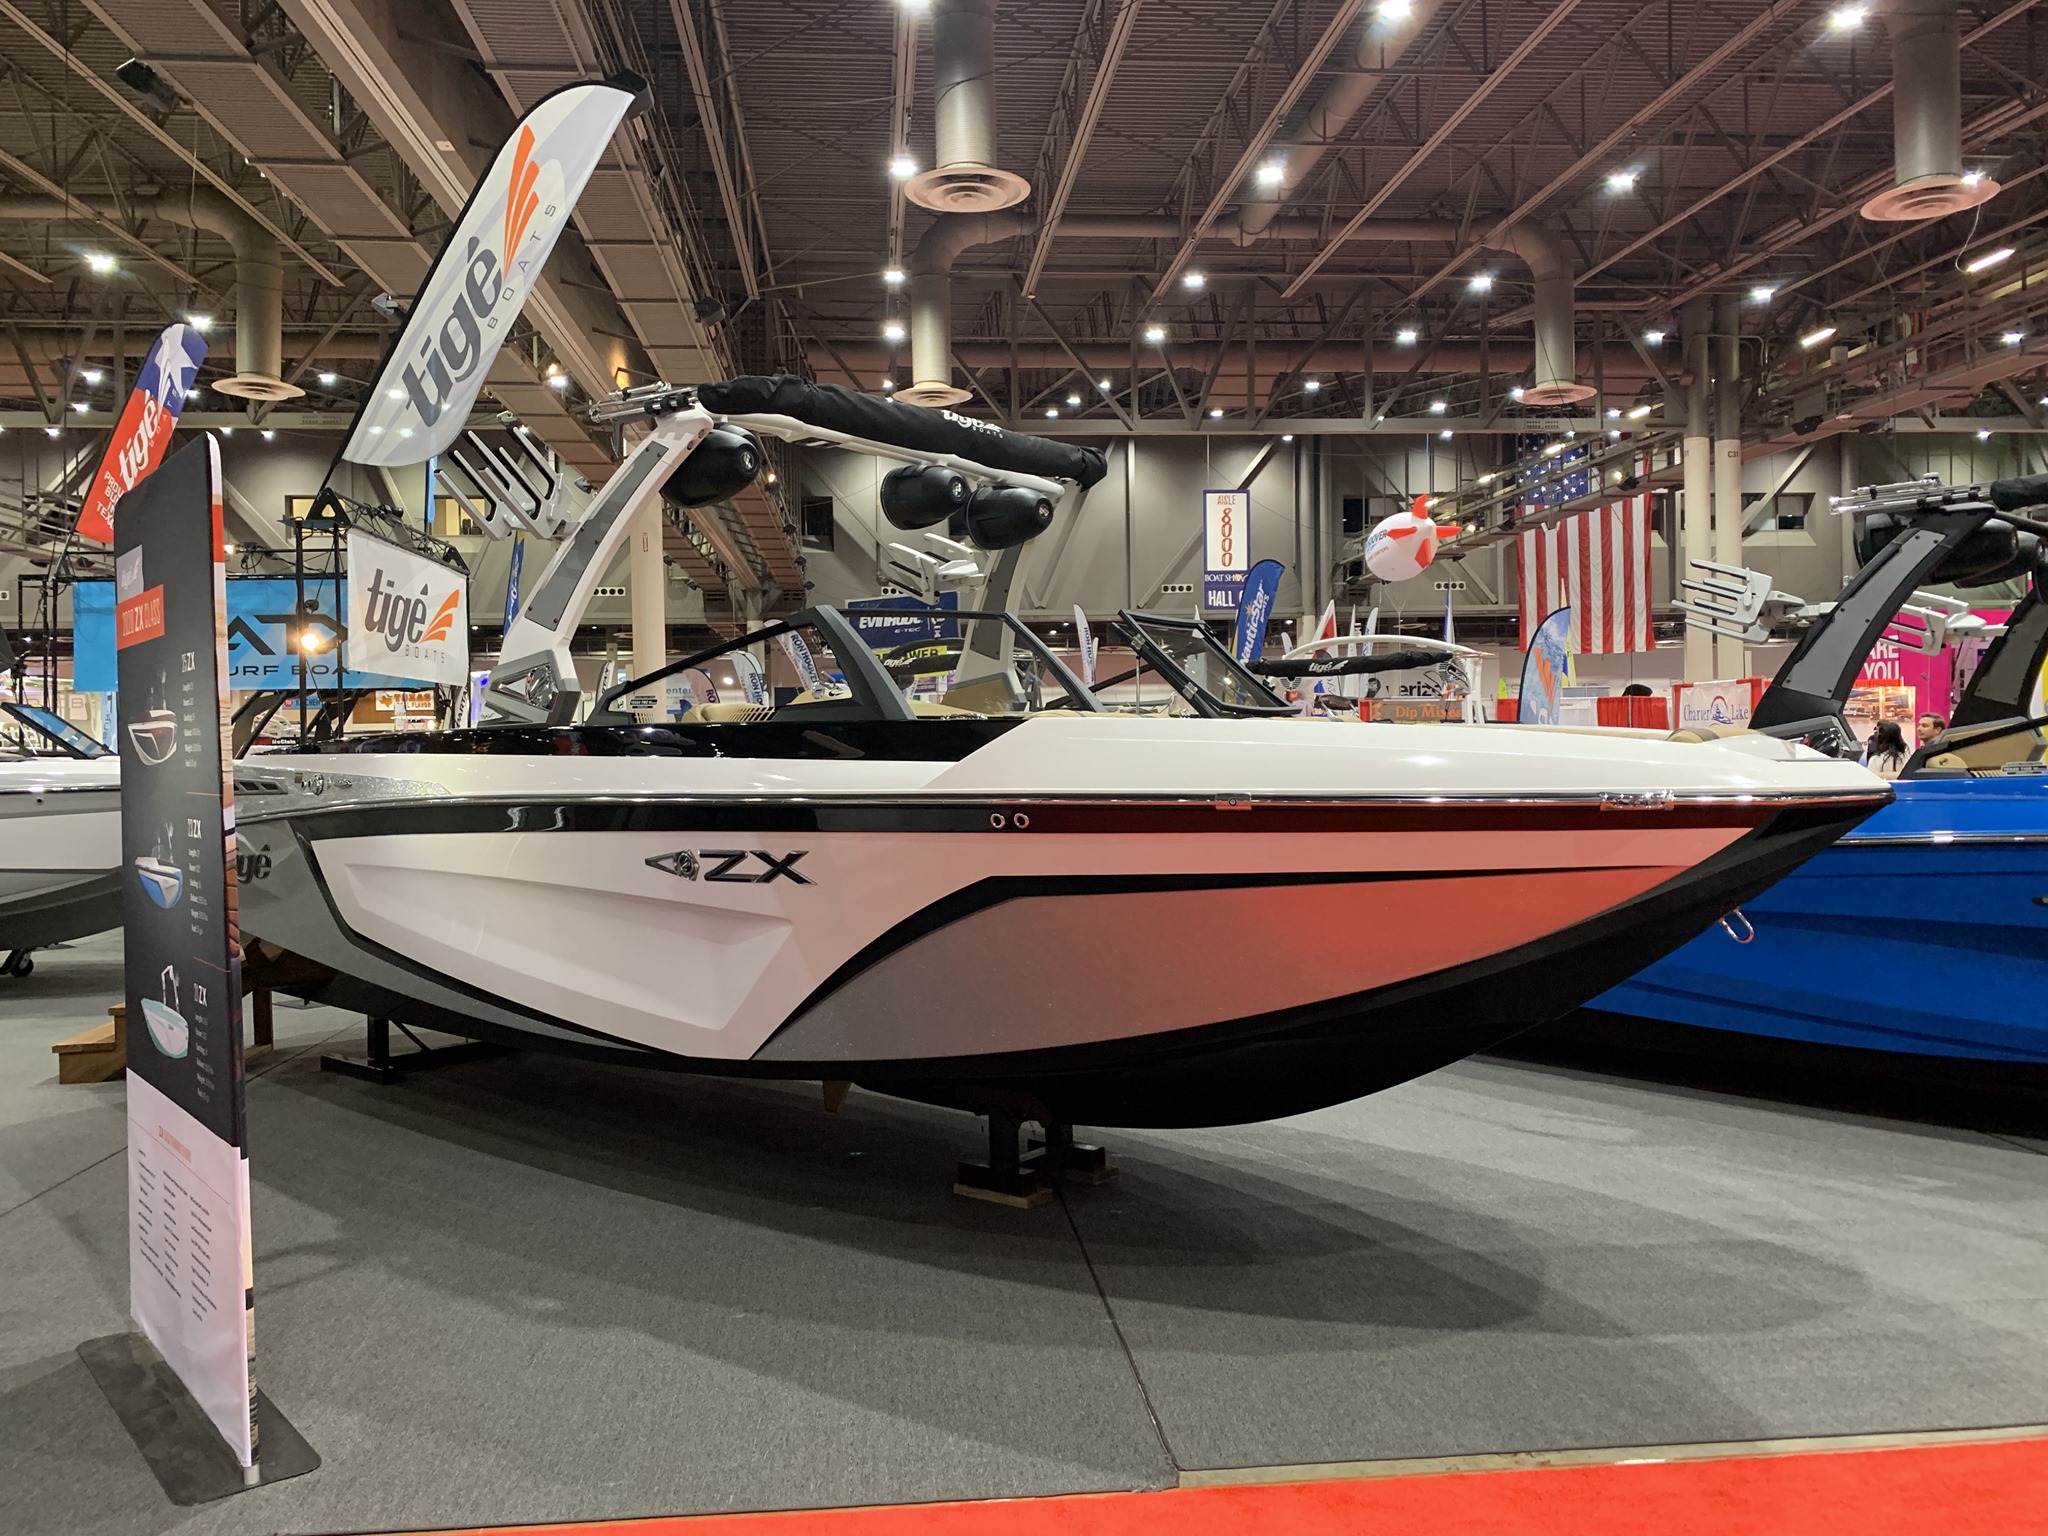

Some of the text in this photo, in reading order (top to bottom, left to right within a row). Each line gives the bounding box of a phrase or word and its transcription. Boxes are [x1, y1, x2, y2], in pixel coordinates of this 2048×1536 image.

[488, 204, 556, 329] BOATS
[1217, 494, 1236, 506] AISLE
[1221, 508, 1233, 567] 8000
[1205, 574, 1224, 582] BOAT
[1208, 590, 1236, 607] HALL
[365, 569, 430, 653] tigé
[1240, 580, 1264, 667] NauticStar
[406, 644, 446, 664] BOATS
[790, 634, 807, 652] RON
[801, 651, 819, 684] HOOVE
[229, 664, 280, 676] URF
[1864, 661, 1899, 680] YOU
[749, 673, 760, 690] RON
[1395, 706, 1418, 720] Dip
[1684, 703, 1749, 722] Charter Lake
[699, 849, 818, 885] ZX
